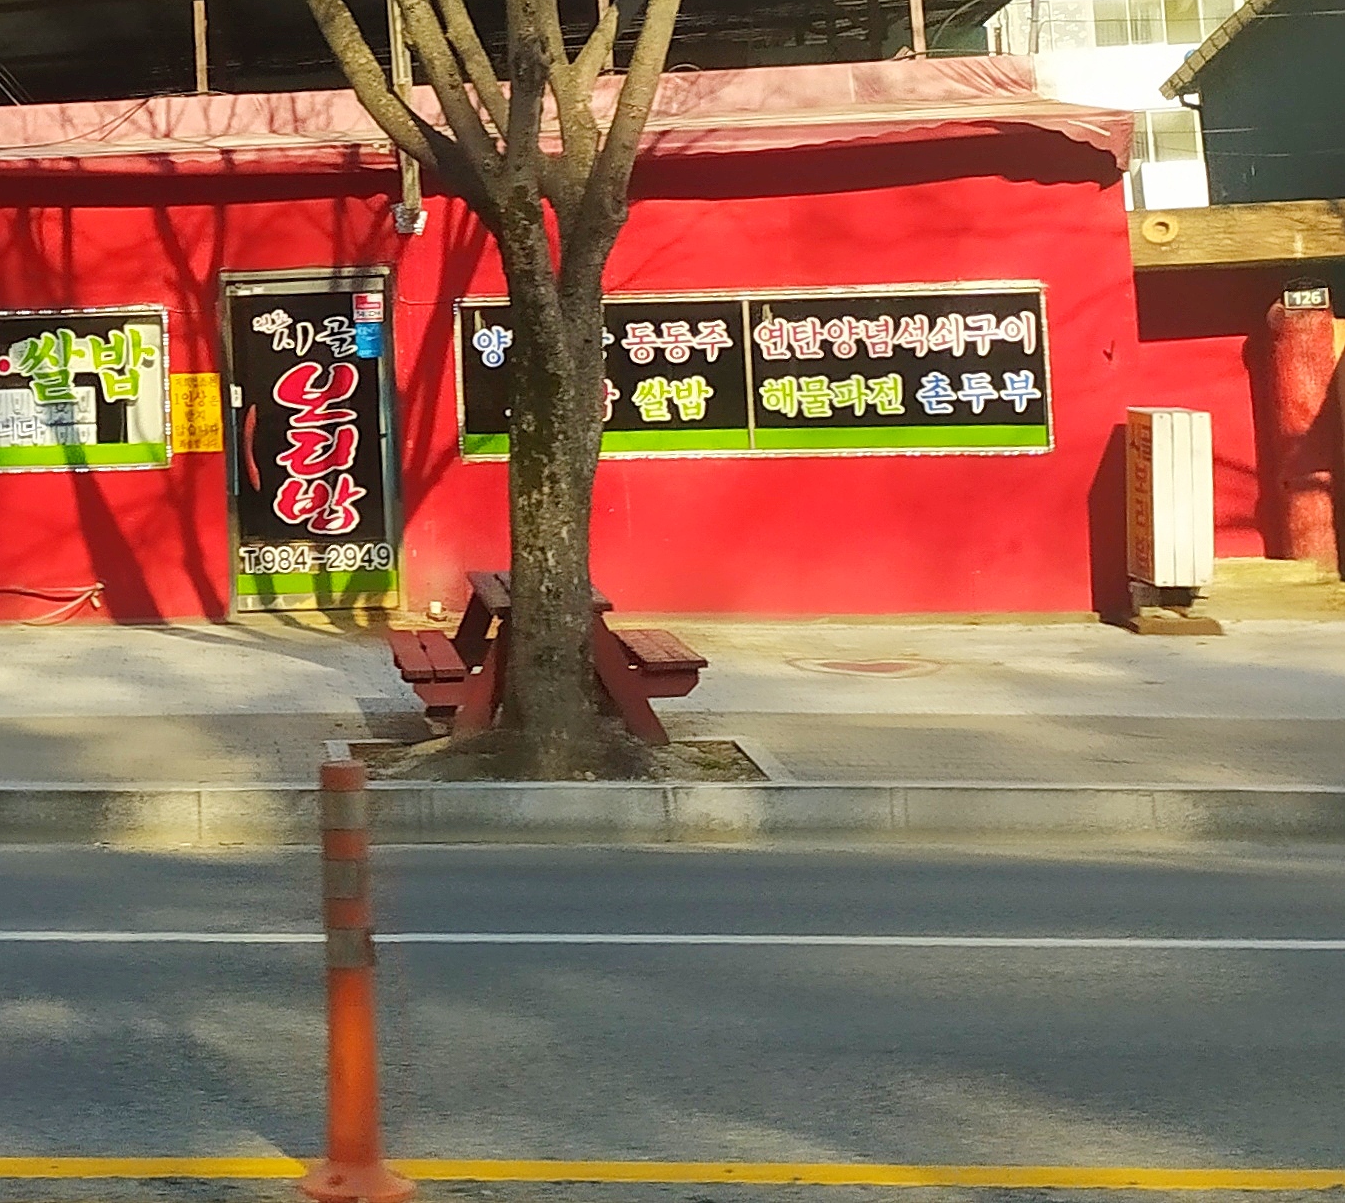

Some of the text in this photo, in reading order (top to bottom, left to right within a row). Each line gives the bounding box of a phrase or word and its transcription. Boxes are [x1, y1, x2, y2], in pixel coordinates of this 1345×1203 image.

[1292, 291, 1322, 306] 126
[272, 316, 358, 358] 시골
[622, 322, 734, 366] 동동주
[632, 376, 714, 422] 쌀밥
[759, 371, 1042, 419] 해물파전 촌두부
[273, 362, 367, 535] 보리밥
[239, 544, 394, 575] T.984-2949
